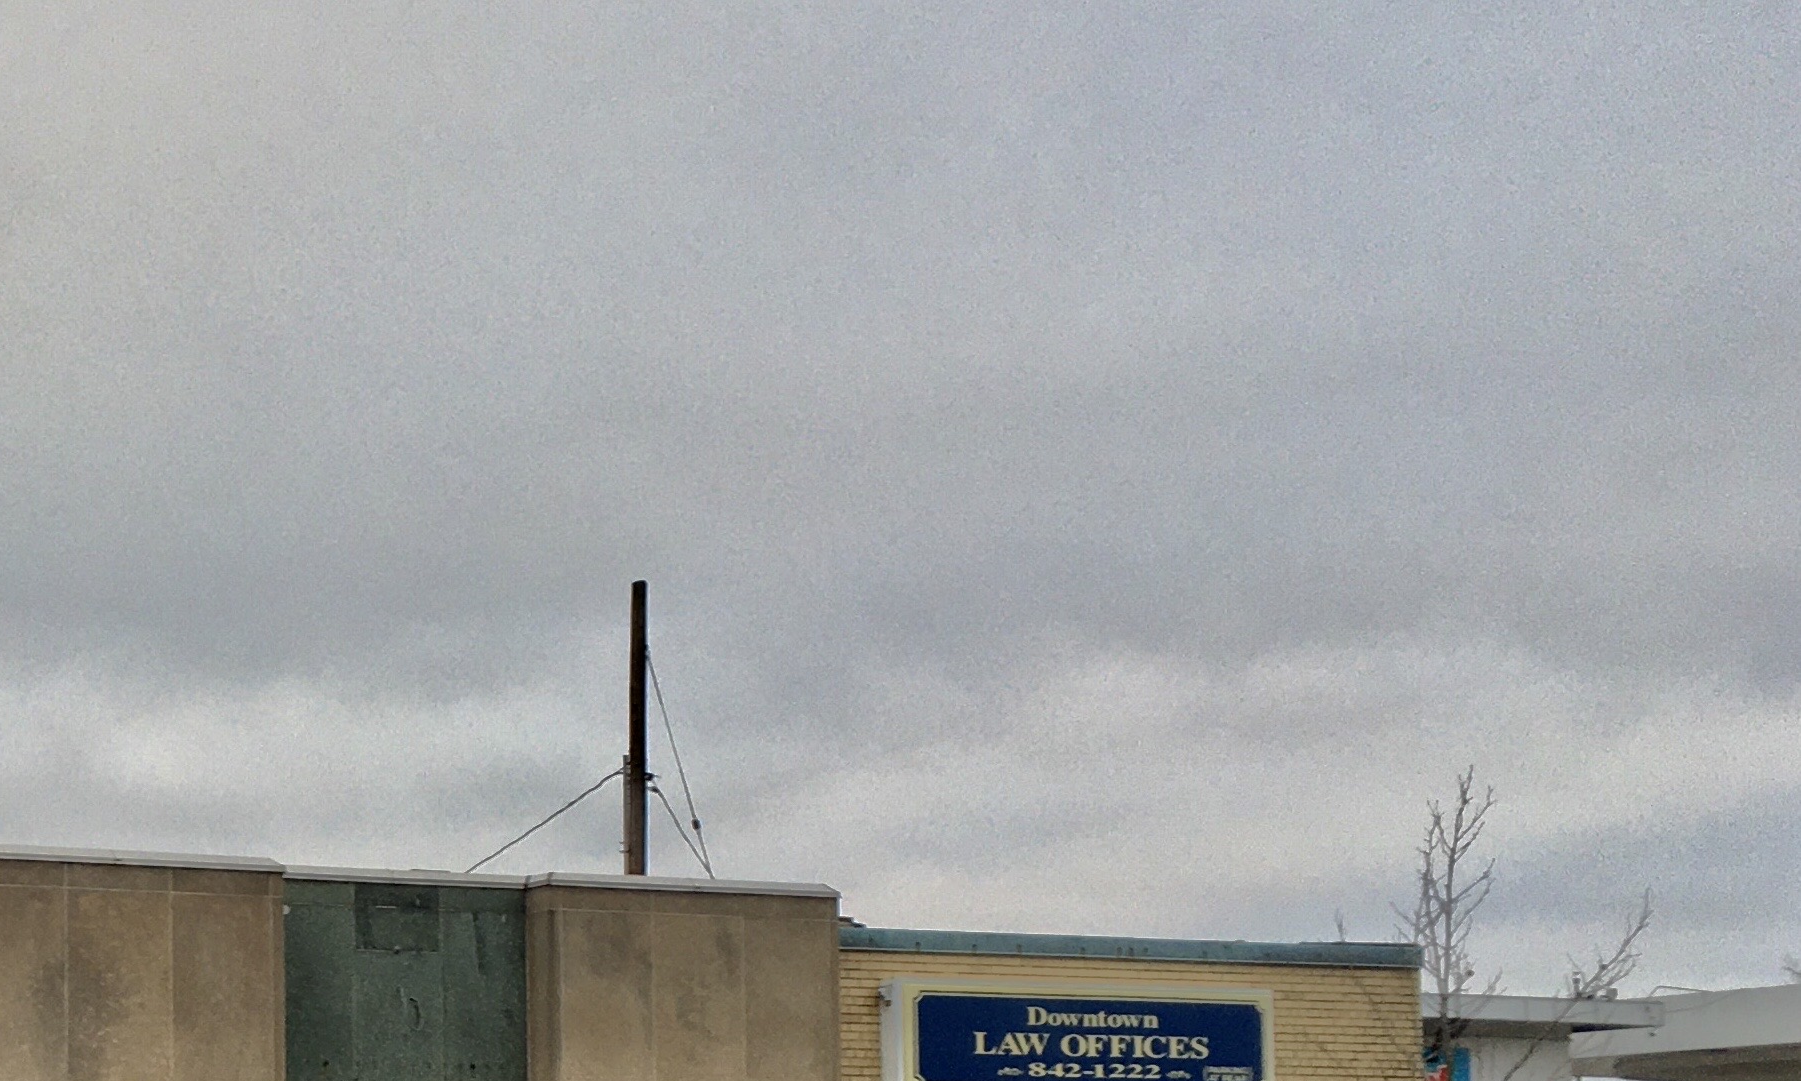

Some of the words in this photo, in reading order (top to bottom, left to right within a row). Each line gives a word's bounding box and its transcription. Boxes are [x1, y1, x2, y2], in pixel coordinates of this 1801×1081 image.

[1026, 1006, 1160, 1029] Downtown
[973, 1031, 1051, 1056] LAW
[1060, 1033, 1210, 1060] OFFICES
[1027, 1062, 1162, 1079] 842-1222
